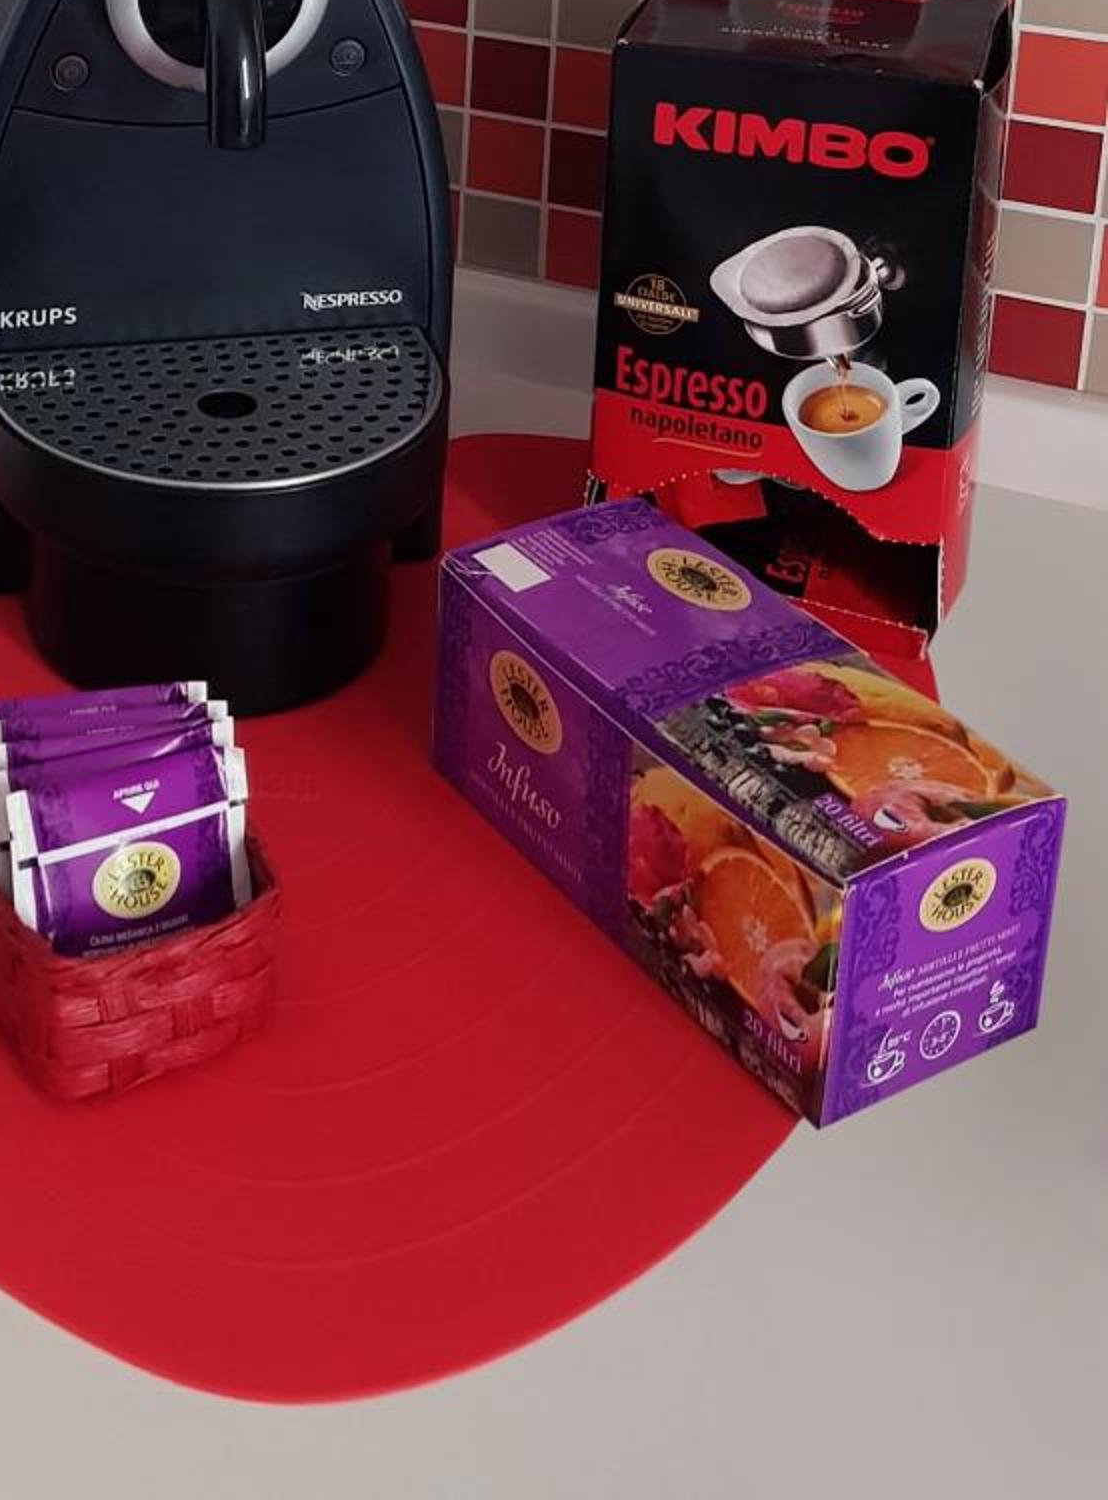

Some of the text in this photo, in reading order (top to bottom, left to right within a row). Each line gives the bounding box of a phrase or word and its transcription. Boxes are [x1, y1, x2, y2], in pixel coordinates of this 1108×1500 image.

[653, 102, 930, 180] KIMBO
[301, 289, 403, 311] NESPRESSO
[616, 345, 767, 419] Espresso
[630, 407, 763, 449] napoletano
[487, 740, 561, 829] Infuso
[814, 792, 884, 848] 20 filtri
[107, 851, 165, 882] LESTER
[933, 867, 984, 900] LESTER
[110, 881, 169, 910] HOUSE
[931, 891, 985, 924] HOUSE
[743, 1009, 803, 1076] 20 filtri
